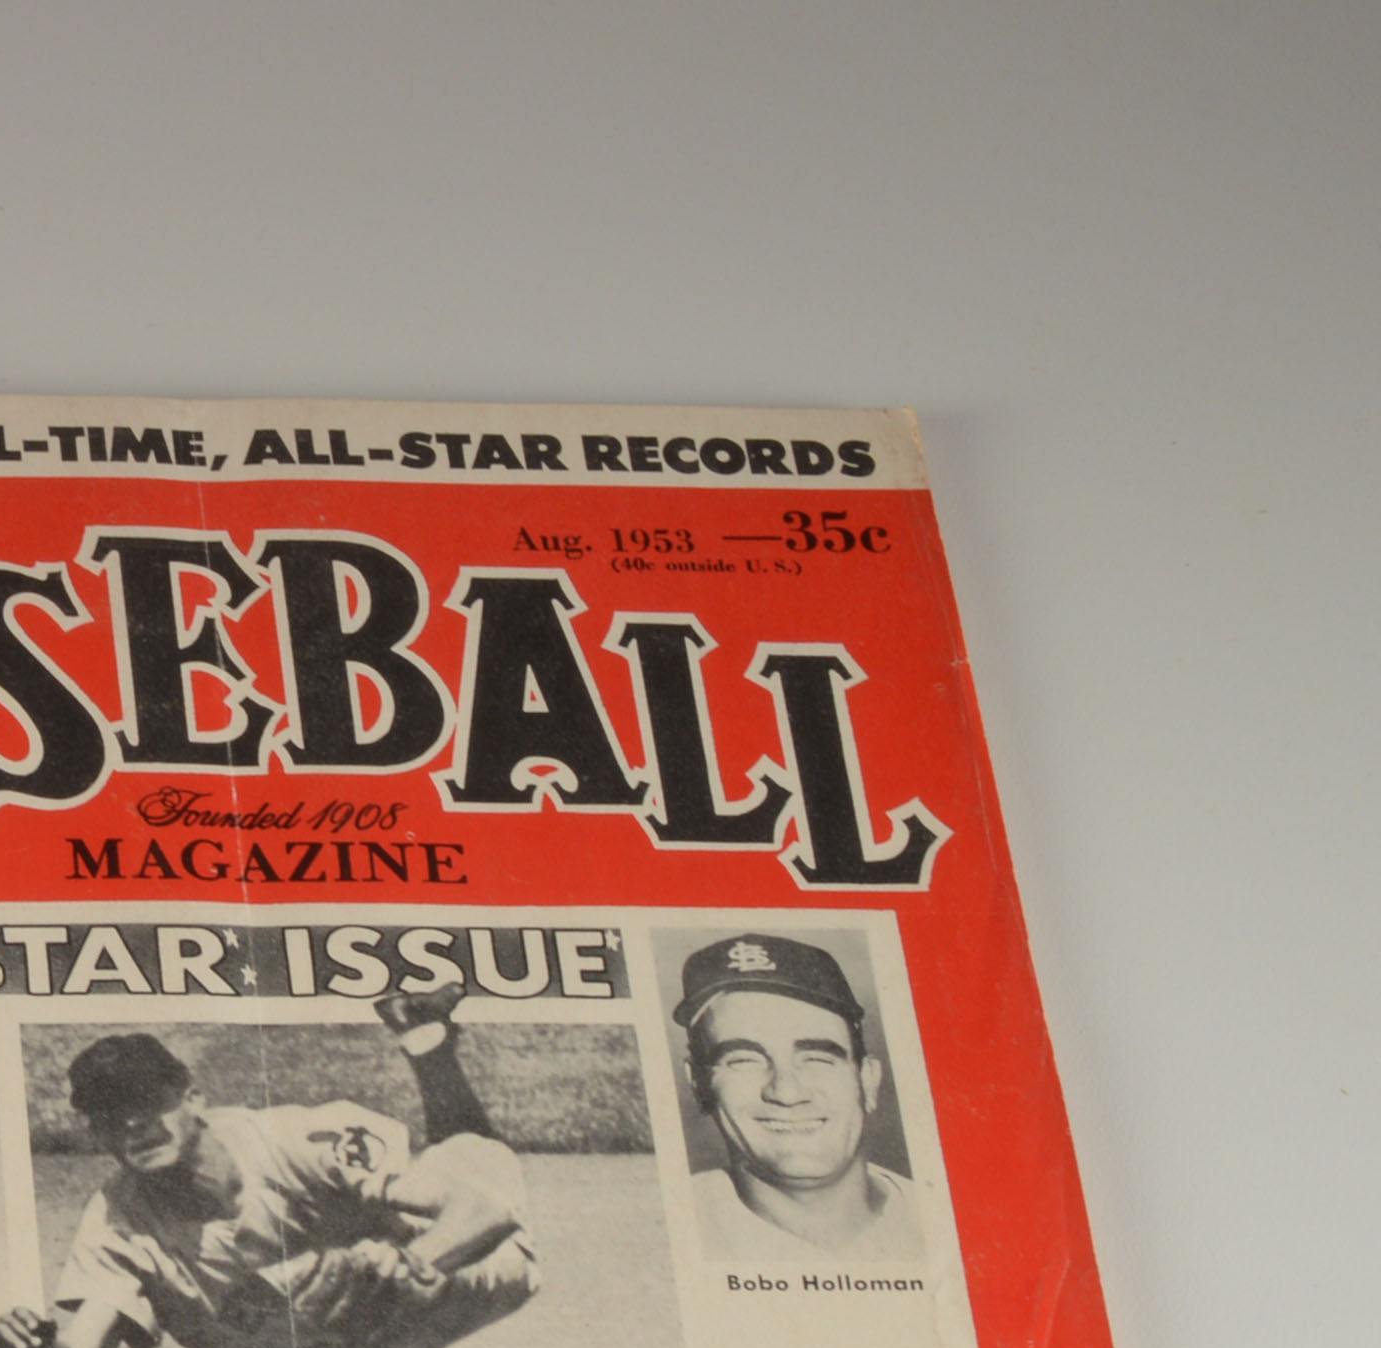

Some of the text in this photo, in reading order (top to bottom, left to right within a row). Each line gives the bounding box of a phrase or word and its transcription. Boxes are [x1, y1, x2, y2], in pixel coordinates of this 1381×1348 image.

[243, 430, 569, 471] ALL-STAR
[581, 434, 877, 478] RECORDS
[513, 526, 593, 560] Aug.
[610, 528, 696, 553] 1953
[610, 558, 656, 574] (40c
[665, 560, 736, 574] outside
[136, 786, 409, 833] Founded 1908
[64, 837, 469, 885] MAGAZINE
[283, 926, 617, 1000] ISSUE
[727, 1275, 924, 1291] Bobo Holloman
